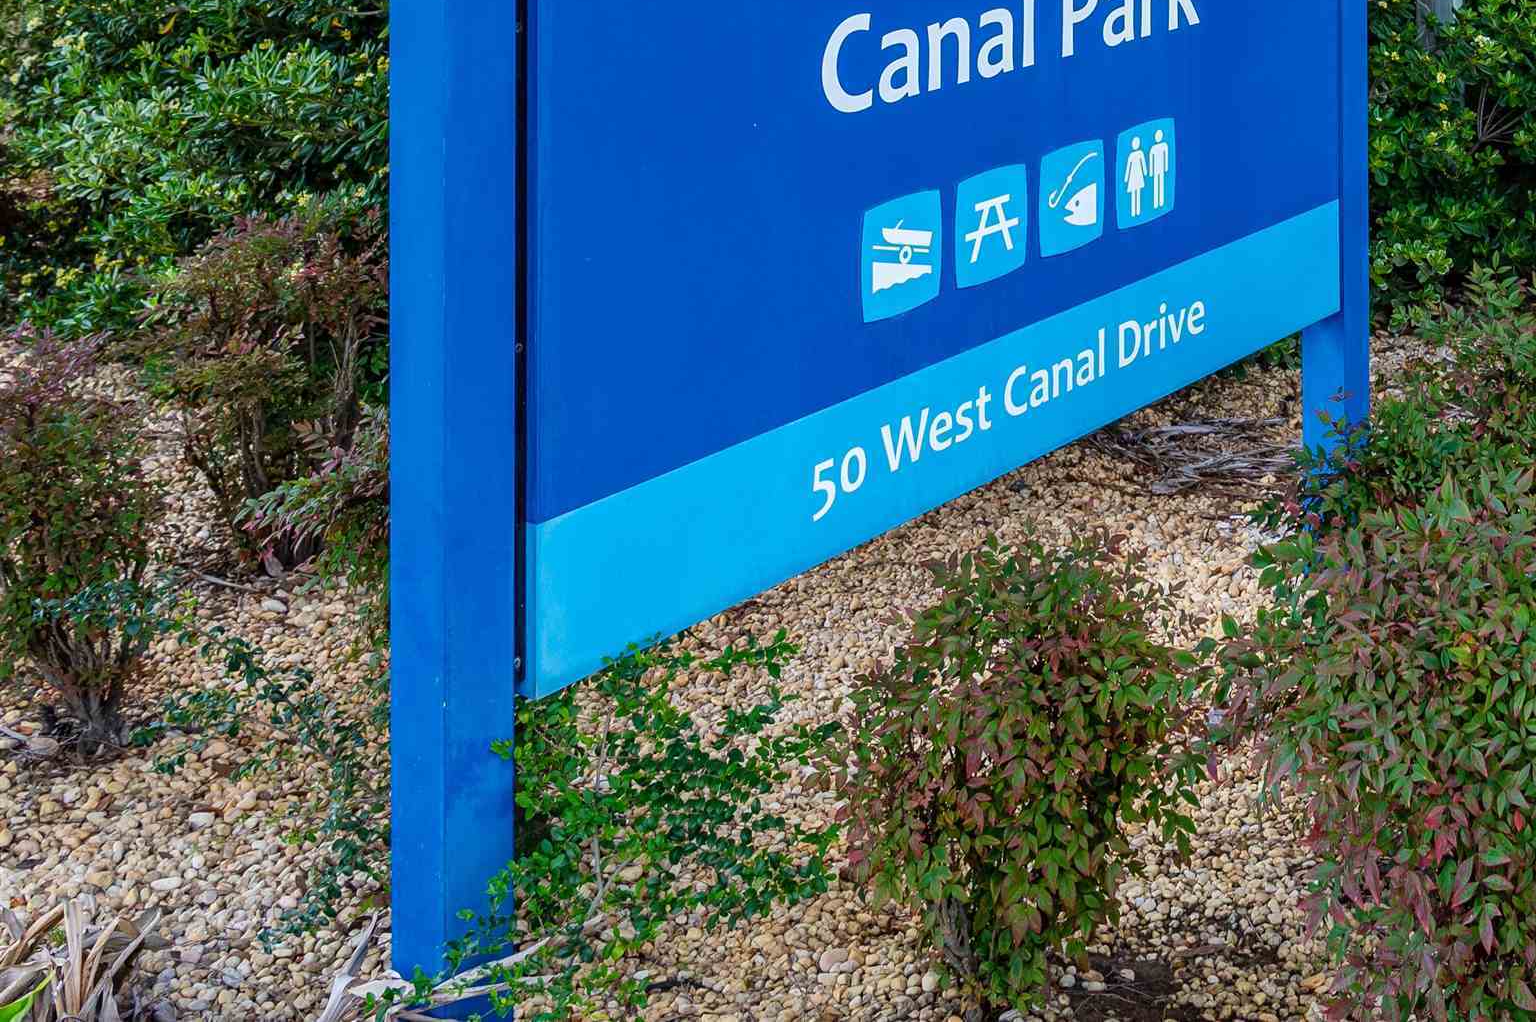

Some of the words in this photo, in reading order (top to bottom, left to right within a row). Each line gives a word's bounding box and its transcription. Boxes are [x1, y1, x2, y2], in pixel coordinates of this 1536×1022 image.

[811, 445, 867, 522] 50
[880, 386, 992, 473] West
[1003, 328, 1105, 418] Canal
[1117, 300, 1206, 369] Drive
